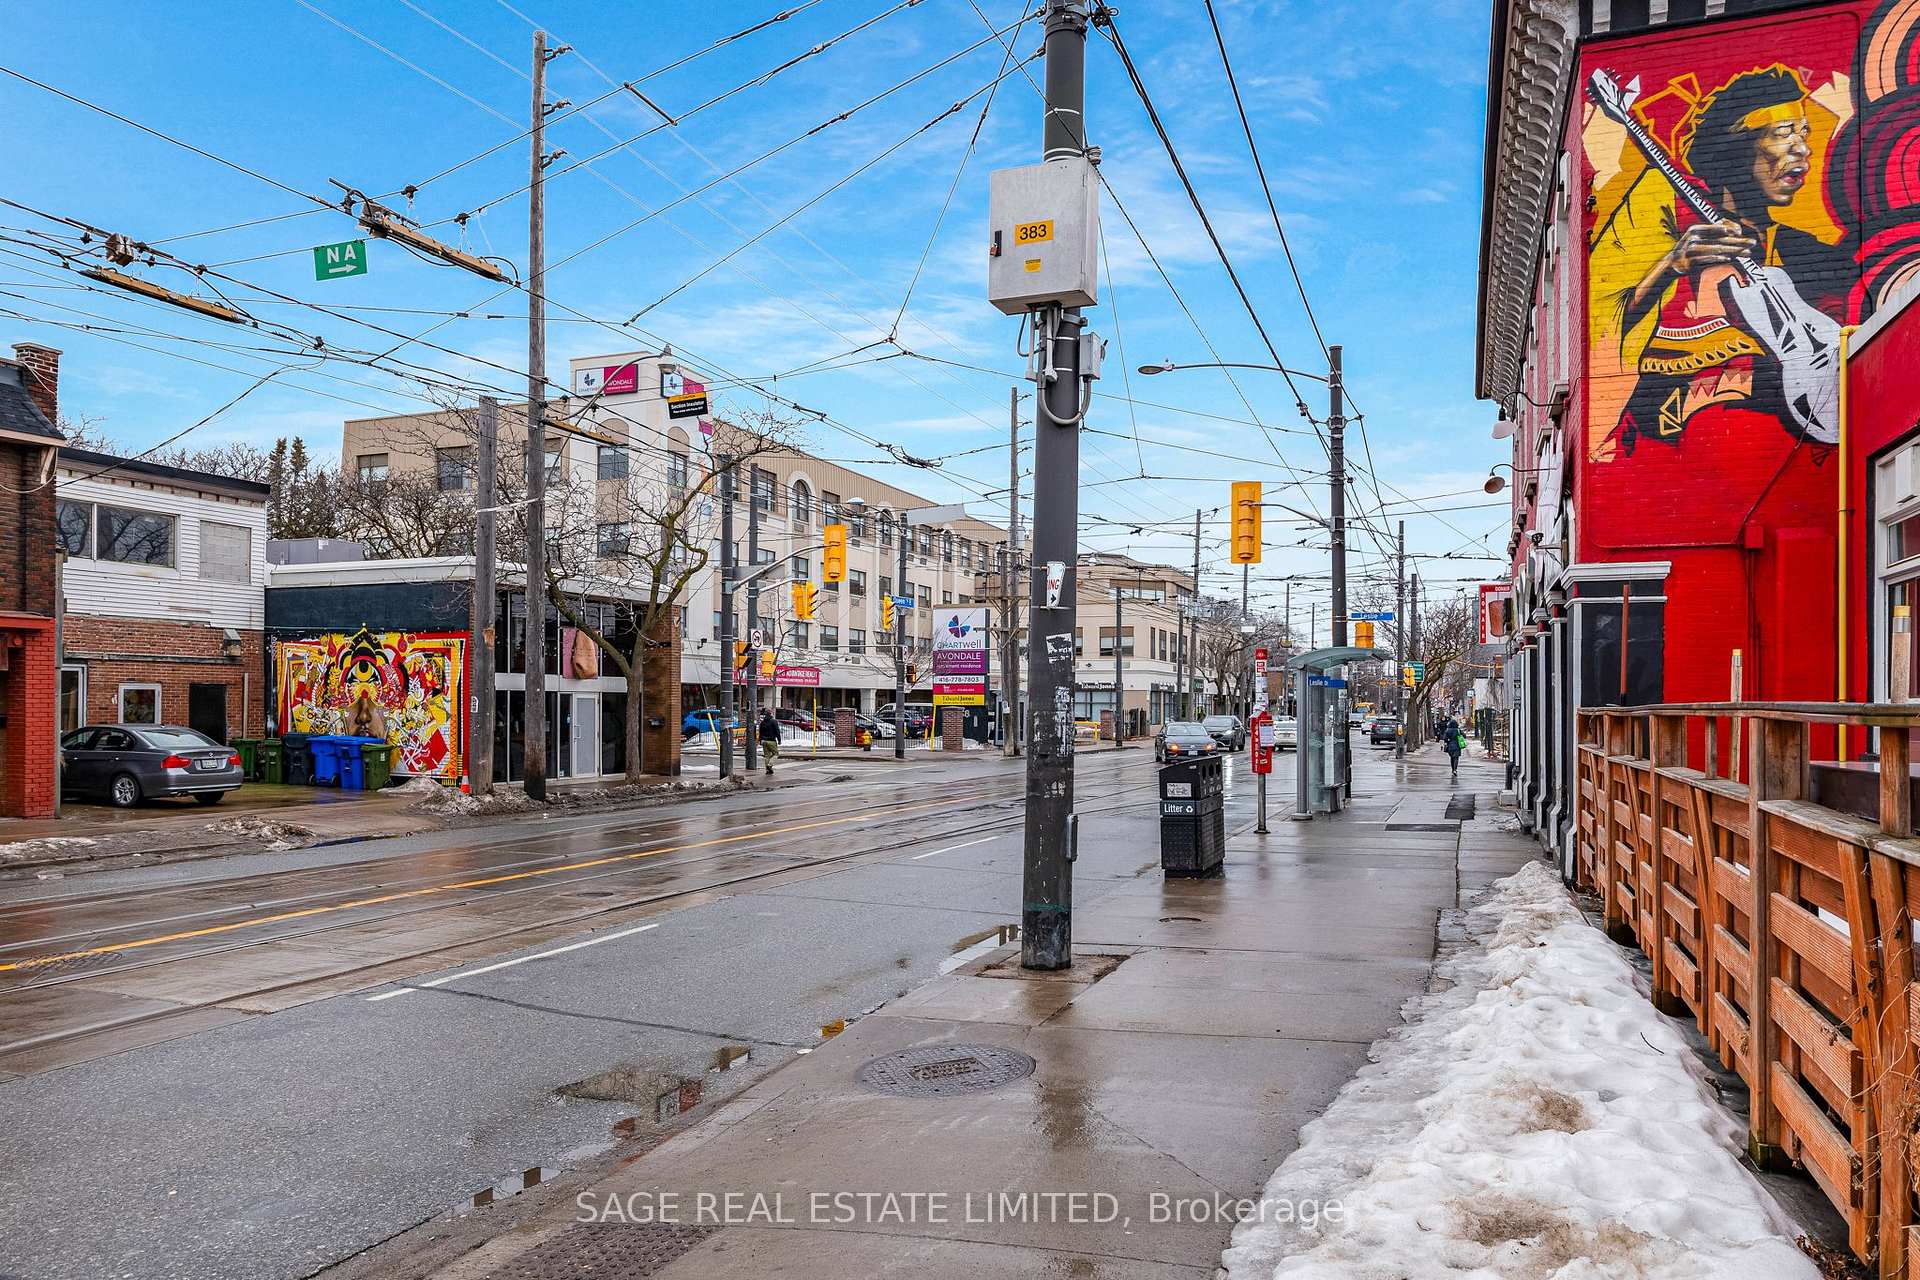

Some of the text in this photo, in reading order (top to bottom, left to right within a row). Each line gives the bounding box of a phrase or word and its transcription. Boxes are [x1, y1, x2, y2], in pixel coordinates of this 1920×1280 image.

[1020, 224, 1047, 240] 383
[937, 652, 981, 661] AVONDALE
[1164, 803, 1183, 813] Litter
